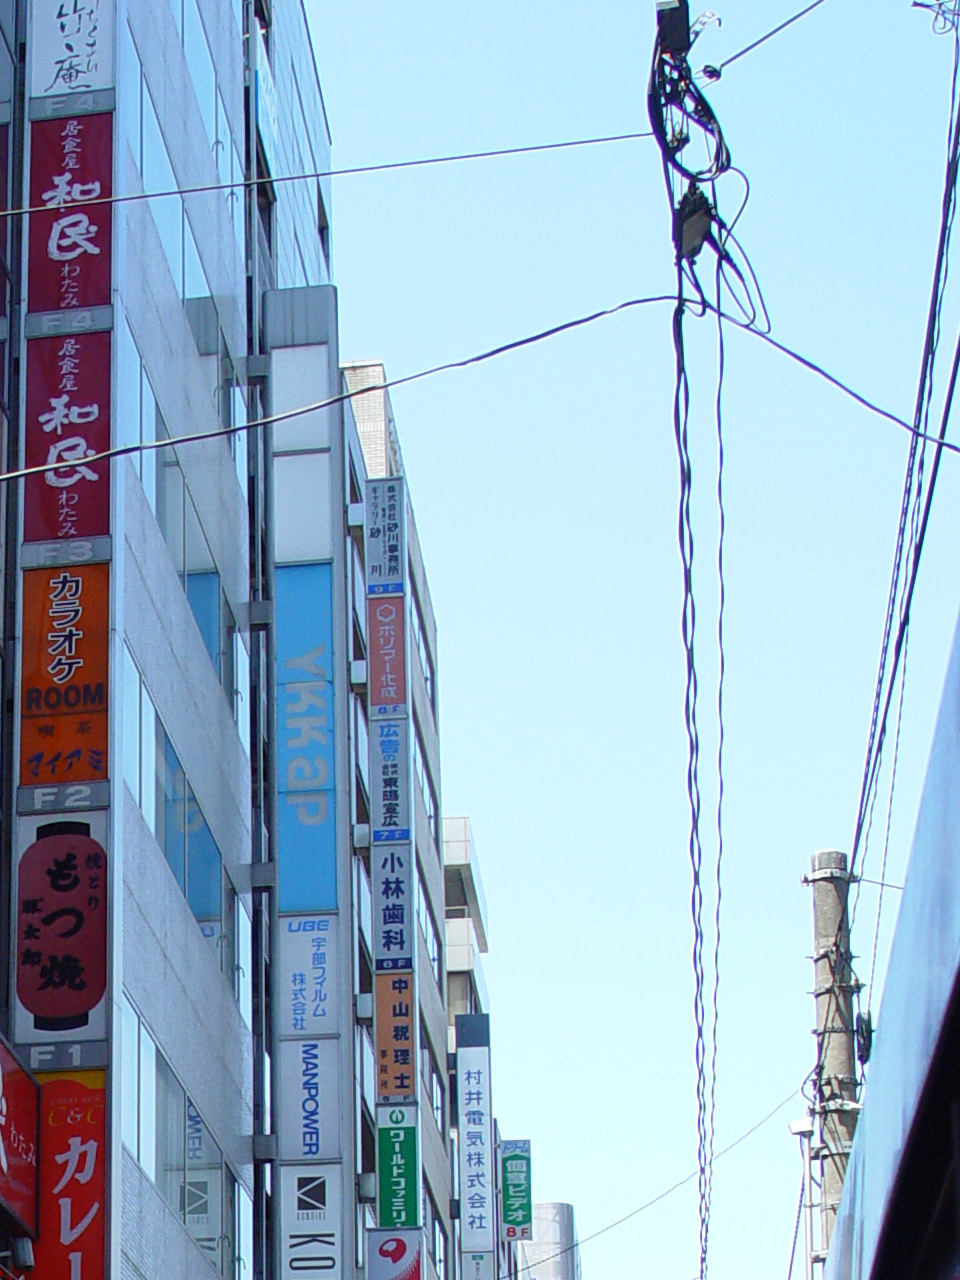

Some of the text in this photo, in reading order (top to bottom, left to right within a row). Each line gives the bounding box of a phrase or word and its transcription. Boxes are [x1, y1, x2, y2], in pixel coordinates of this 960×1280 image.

[41, 120, 102, 308] 居食屋 和民 わたみ
[37, 338, 100, 537] 居食屋 和民 わたみ
[47, 572, 83, 685] カラオケ
[25, 682, 105, 711] ROOM
[25, 747, 105, 778] マイアミ
[36, 851, 87, 992] もつ焼
[287, 919, 331, 933] UBE
[380, 852, 406, 952] 小林歯科
[291, 972, 307, 1031] 株式会社
[311, 936, 327, 1018] 宇部フィルム
[391, 977, 411, 1090] 中山税理士
[301, 1042, 320, 1157] MANPOWER
[464, 1068, 487, 1231] 村井電気株式会社
